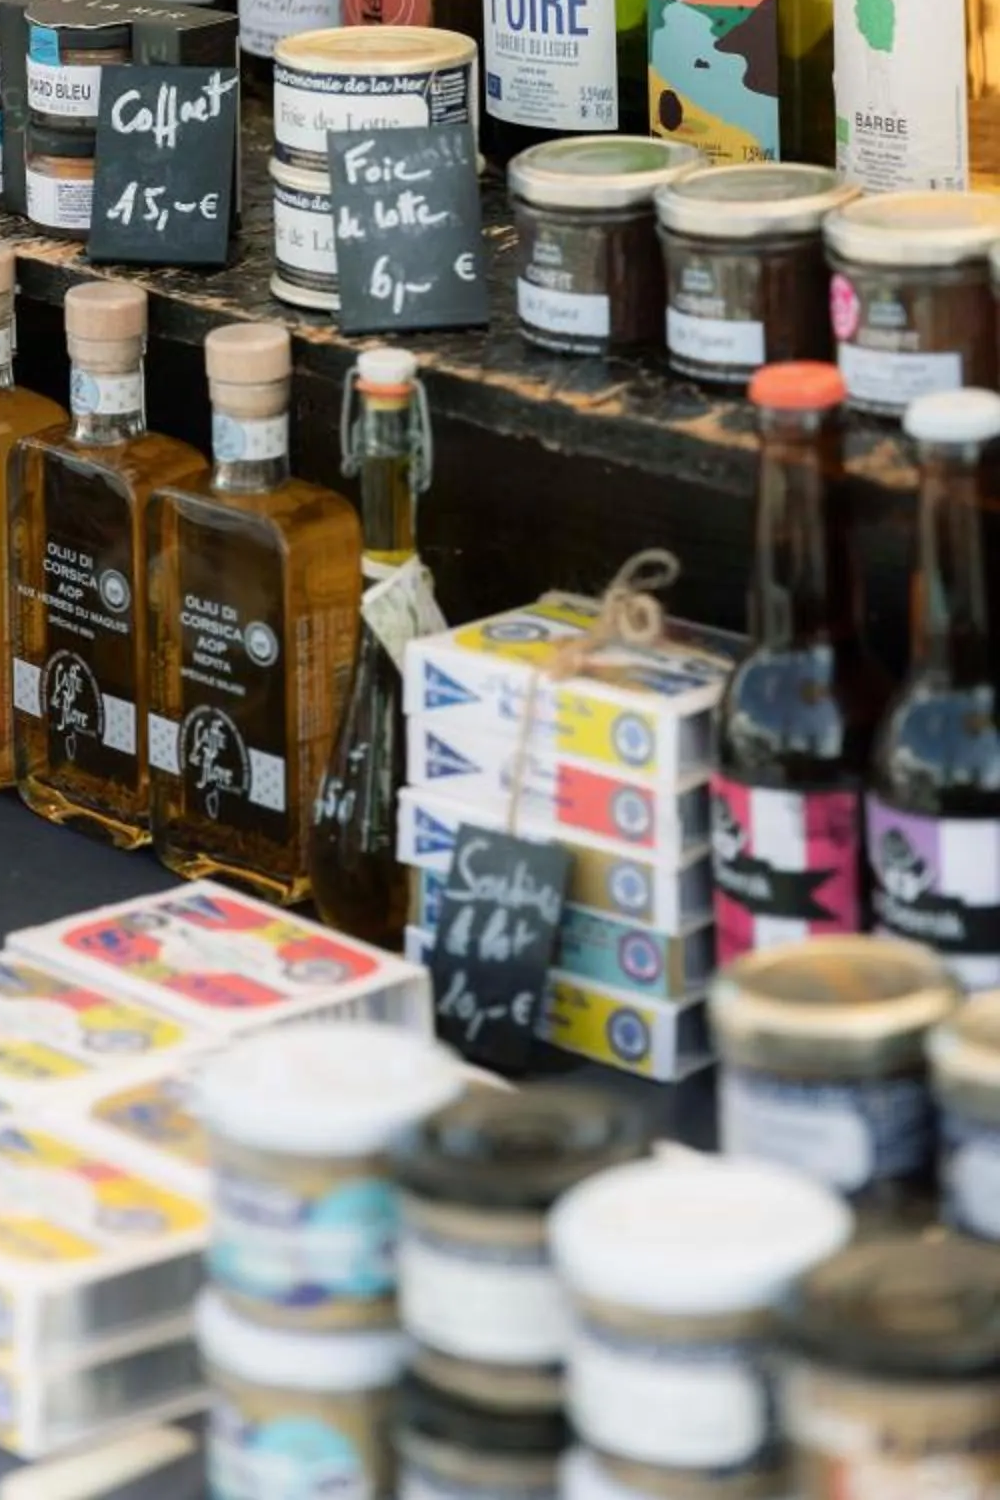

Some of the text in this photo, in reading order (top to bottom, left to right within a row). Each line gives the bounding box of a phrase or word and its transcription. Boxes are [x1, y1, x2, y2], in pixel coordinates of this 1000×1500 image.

[55, 82, 92, 100] BLEU
[855, 111, 908, 135] BARBE
[343, 139, 432, 185] Foie
[454, 252, 477, 281] €
[47, 541, 93, 569] OLIU DI
[43, 558, 99, 589] CORSICA
[57, 582, 84, 601] AOP
[184, 595, 238, 622] OLIU DI
[180, 610, 244, 642] CORSICA
[196, 636, 228, 655] AOP
